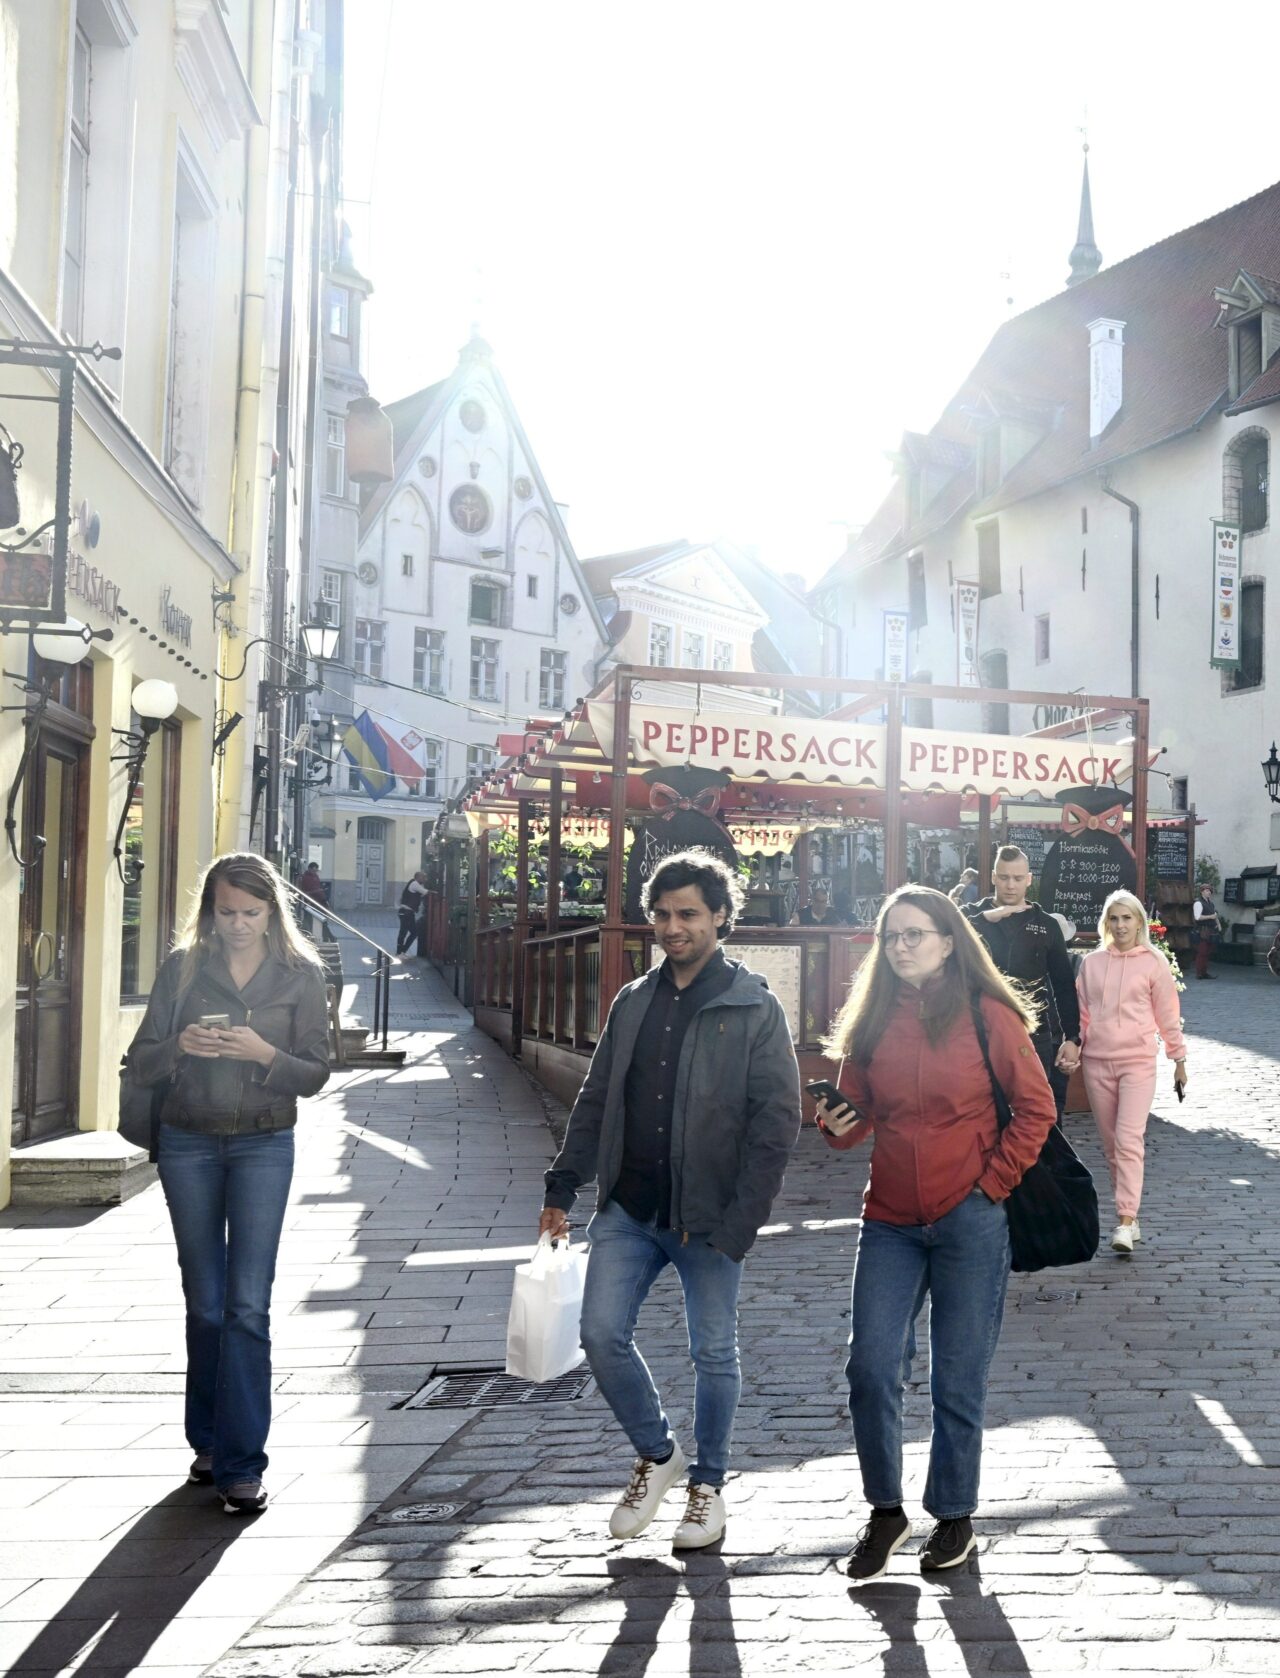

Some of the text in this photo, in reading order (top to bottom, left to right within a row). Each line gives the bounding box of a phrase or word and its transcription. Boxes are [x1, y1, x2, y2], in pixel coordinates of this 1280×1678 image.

[643, 720, 877, 769] PEPPERSACK
[909, 742, 1122, 785] PEPPERSACK
[1082, 915, 1099, 925] 10.0
